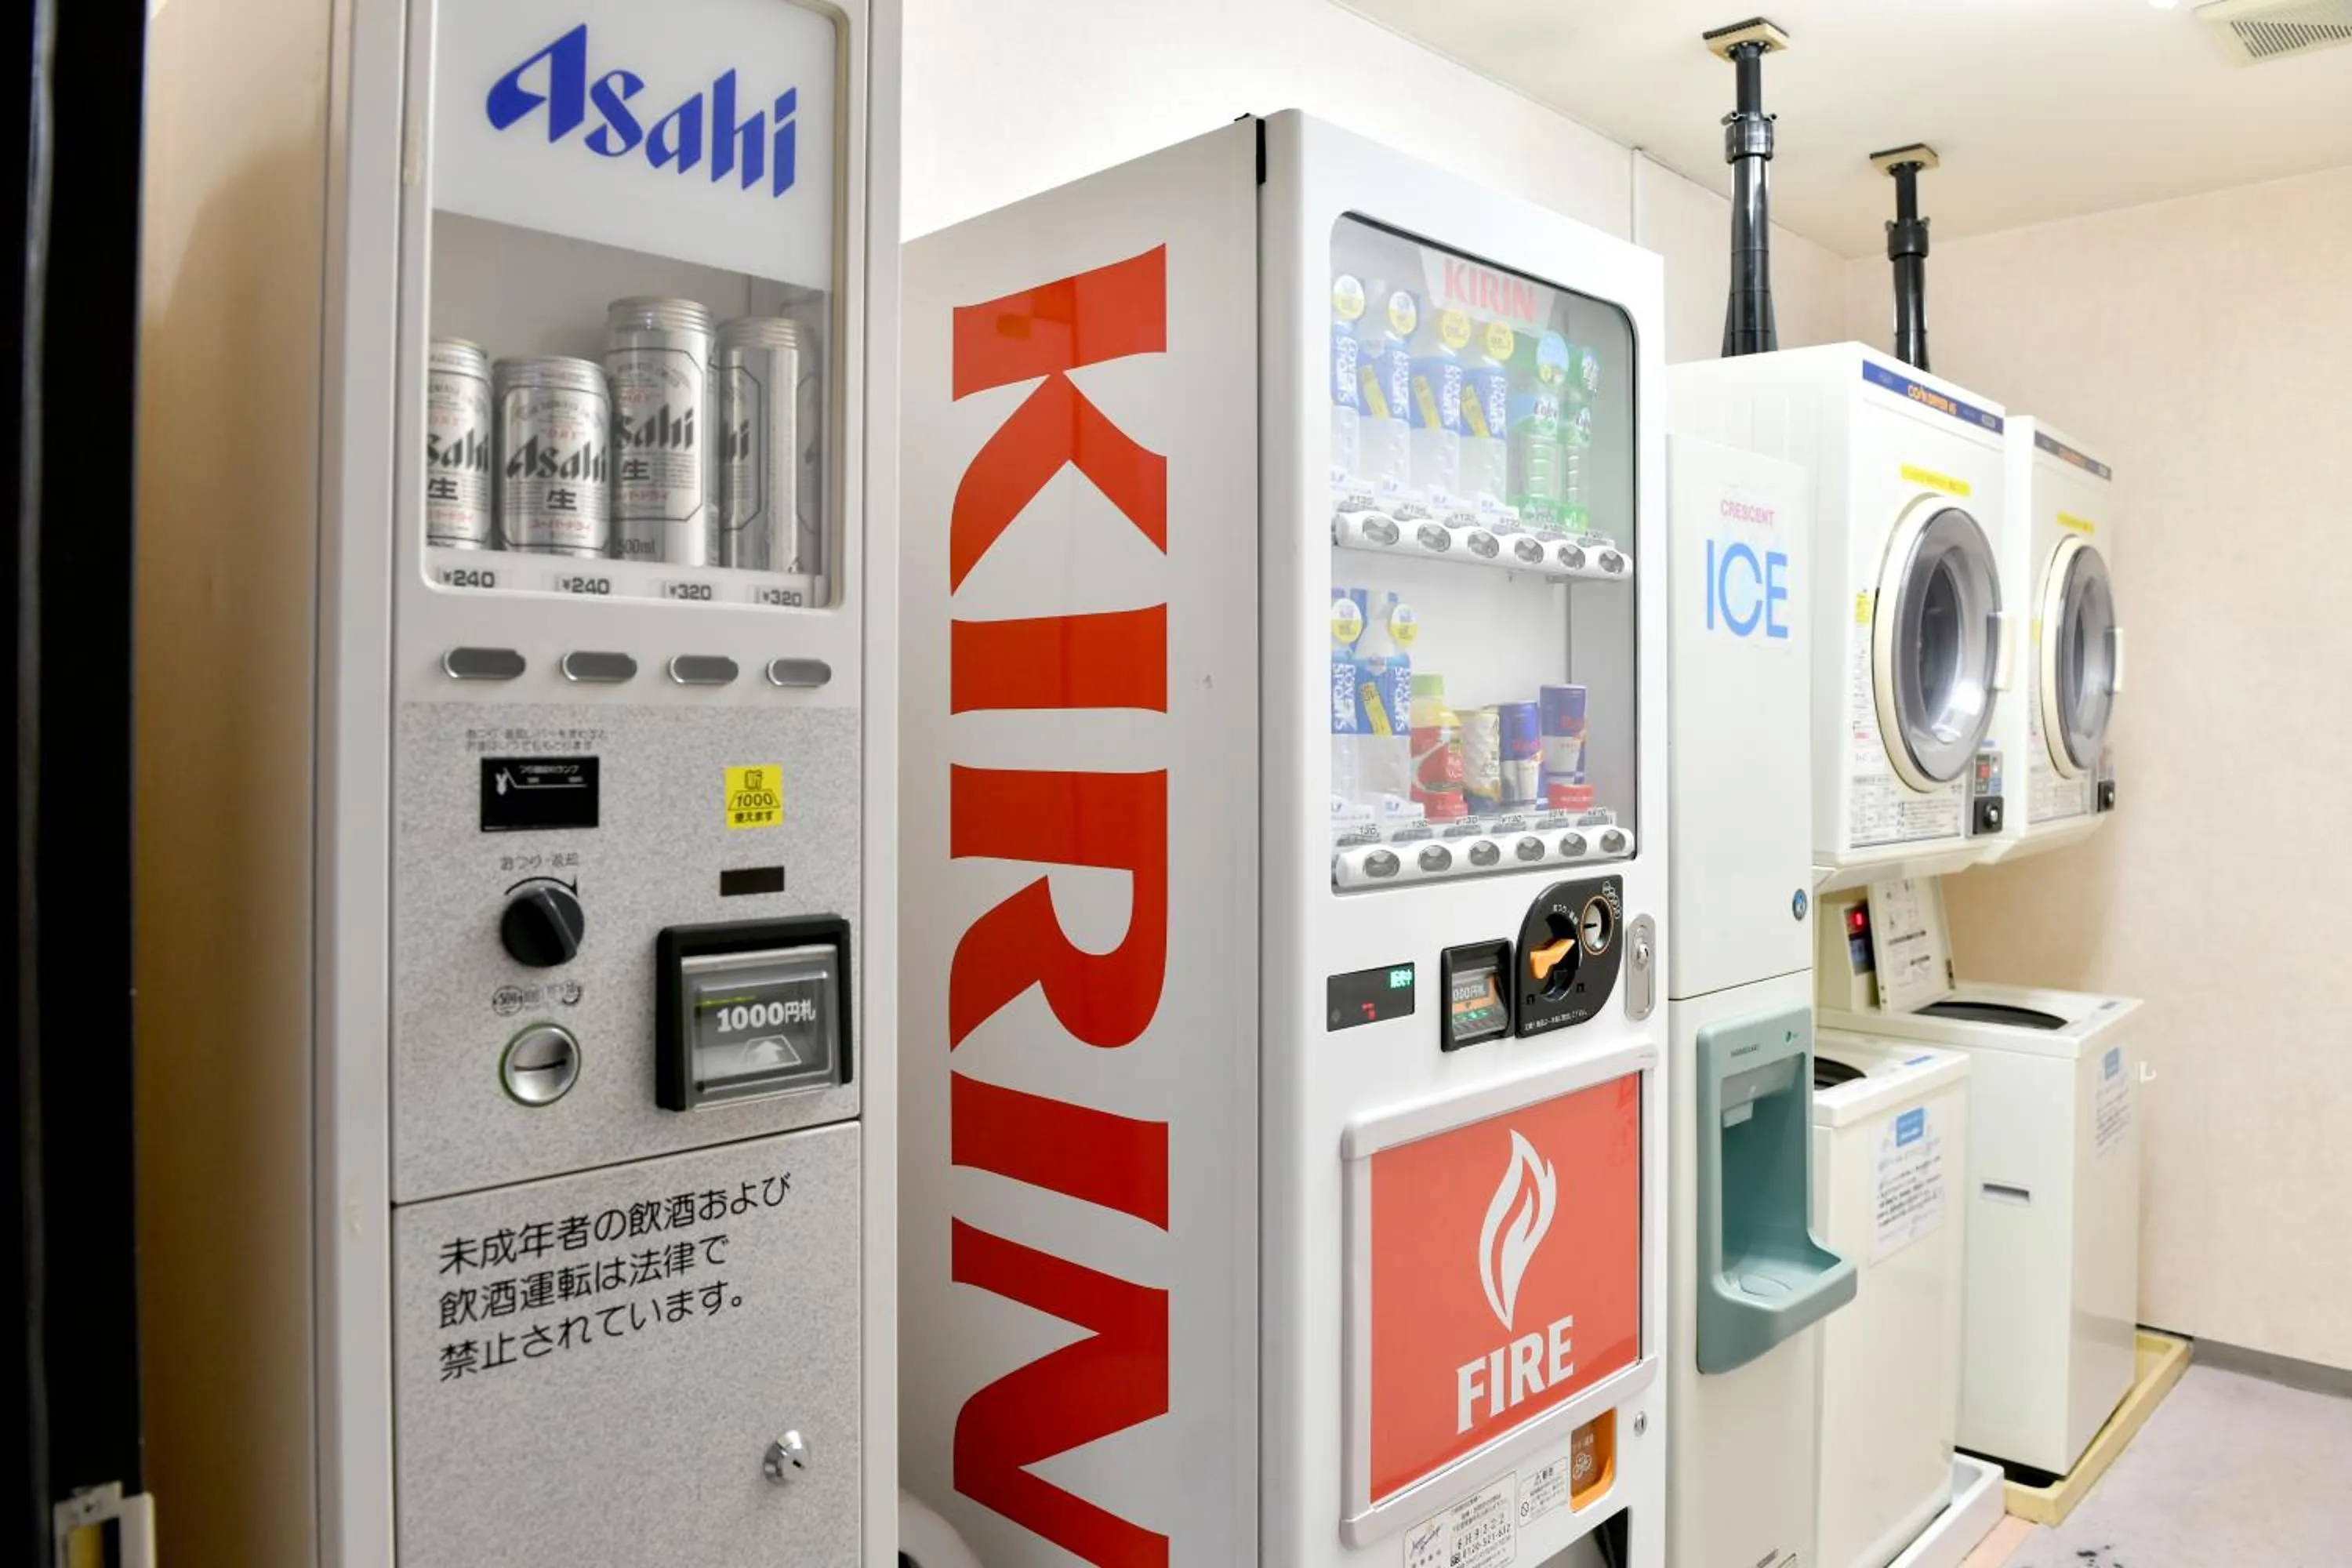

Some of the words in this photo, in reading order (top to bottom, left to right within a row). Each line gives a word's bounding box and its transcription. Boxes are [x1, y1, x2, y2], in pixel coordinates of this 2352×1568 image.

[485, 22, 797, 198] Asahi
[1443, 257, 1537, 324] KIRIN
[614, 404, 694, 449] sahi
[428, 427, 489, 474] sahi
[506, 434, 607, 484] Asahi
[622, 459, 650, 481] 生
[428, 477, 459, 500] 生
[546, 488, 578, 511] 生
[1720, 499, 1775, 526] CRESCENT
[443, 570, 495, 589] ¥240
[561, 577, 610, 596] ¥240
[668, 583, 713, 601] ¥320
[762, 590, 803, 608] ¥320
[1706, 539, 1788, 639] ICE
[736, 792, 773, 807] 1000
[949, 241, 1167, 1568] KIRIN
[717, 999, 816, 1033] 1000円札
[438, 1171, 791, 1276] 未成年者の飲酒および
[438, 1234, 730, 1329] 飲酒運転は法律で
[439, 1280, 742, 1382] 禁止されています。
[1456, 1314, 1574, 1435] FIRE
